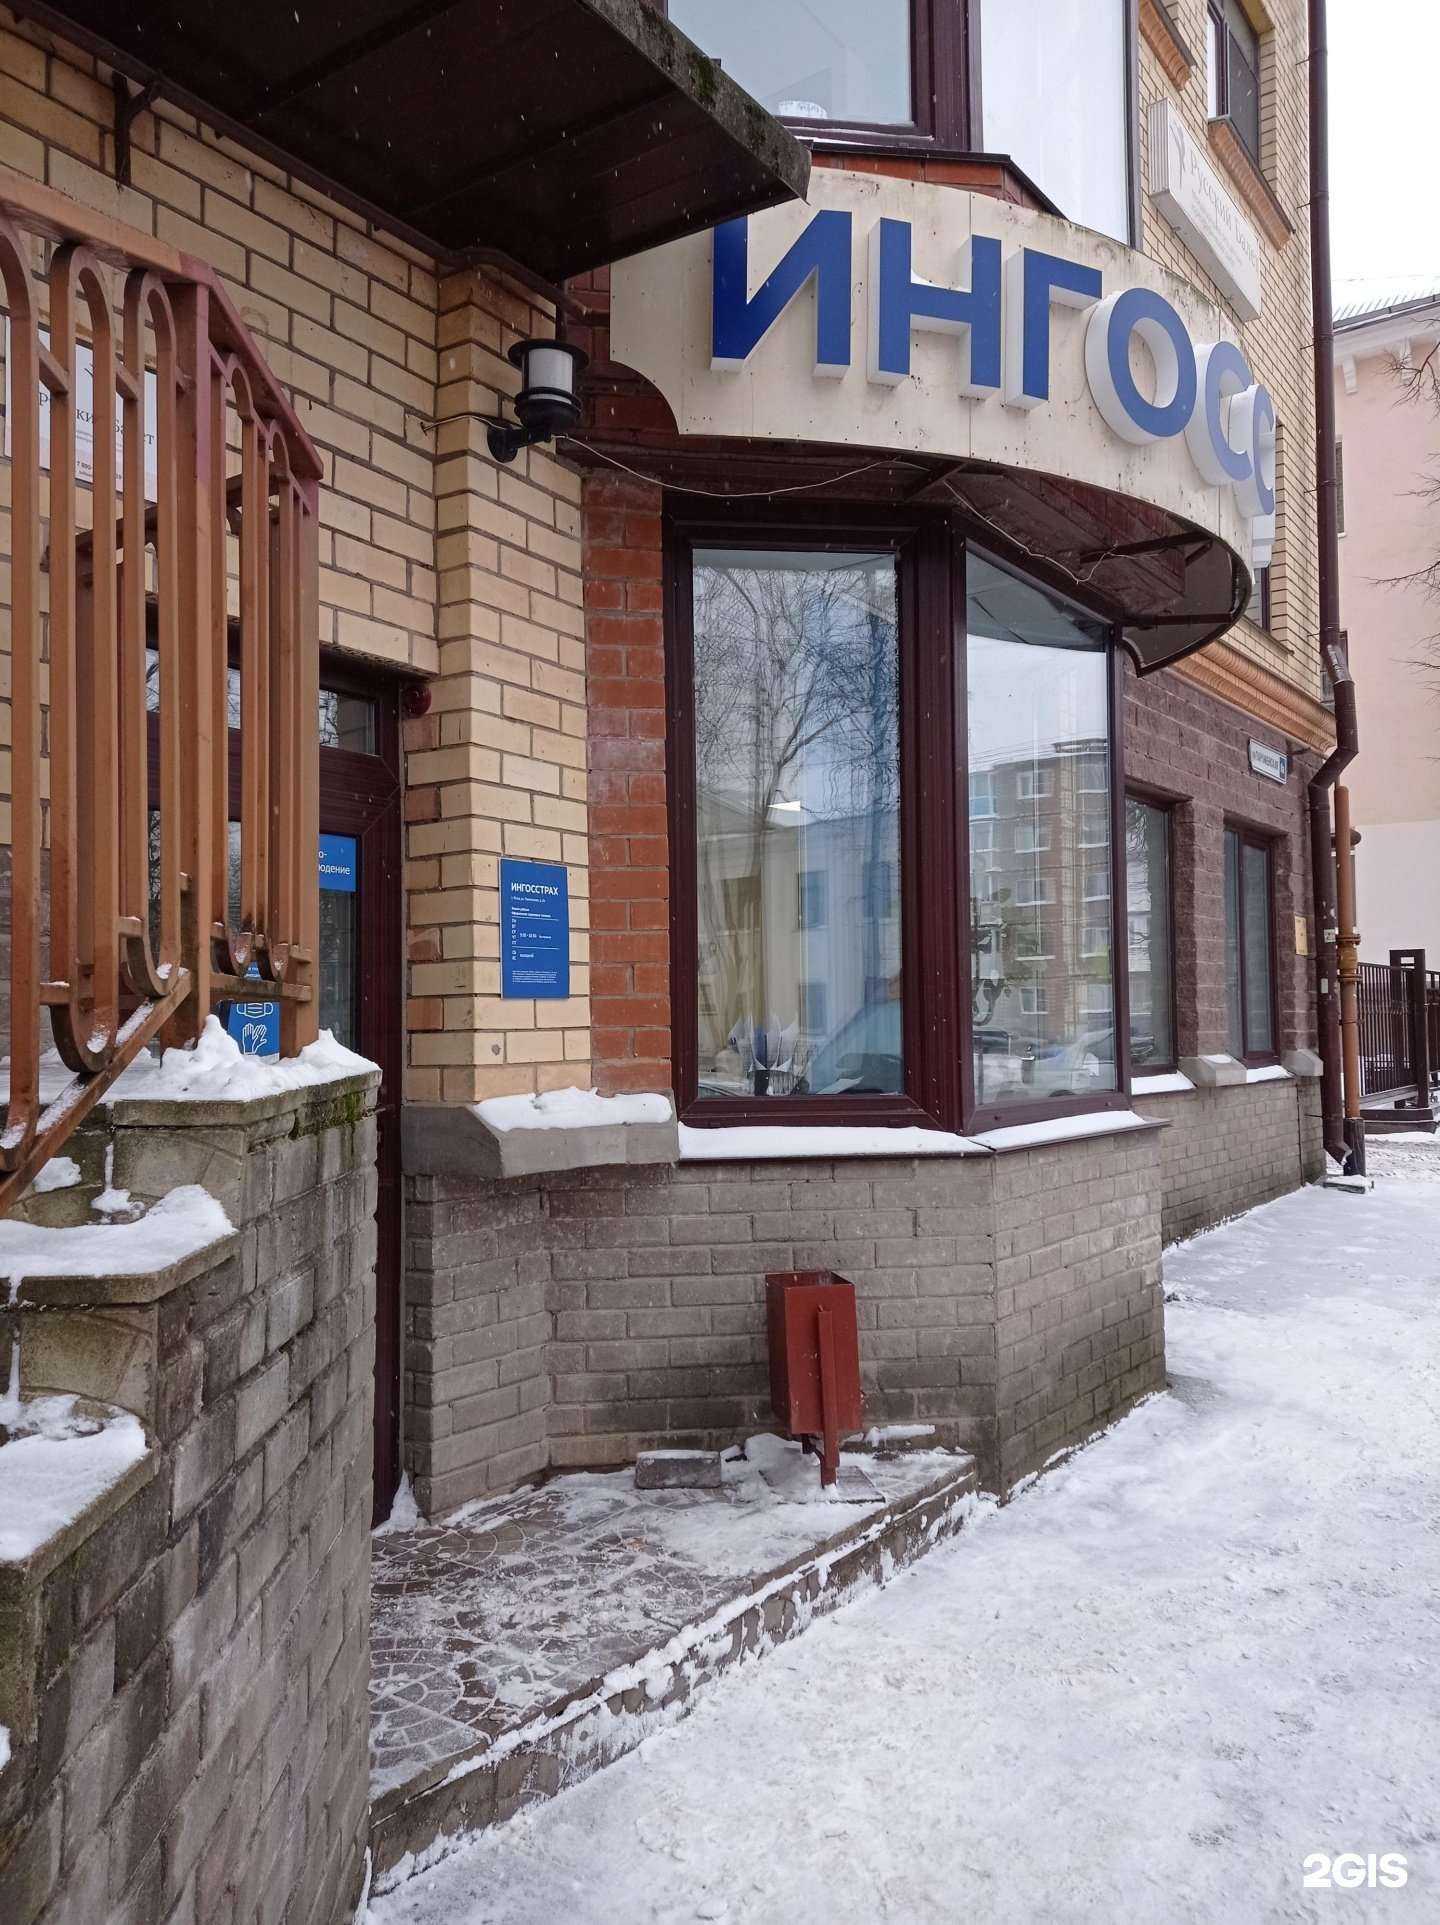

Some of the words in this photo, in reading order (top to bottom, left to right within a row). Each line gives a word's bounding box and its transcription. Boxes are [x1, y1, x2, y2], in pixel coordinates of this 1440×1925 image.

[1190, 149, 1232, 233] Русский
[318, 863, 351, 876] юдение
[511, 882, 560, 896] ИНГОССТРАХ
